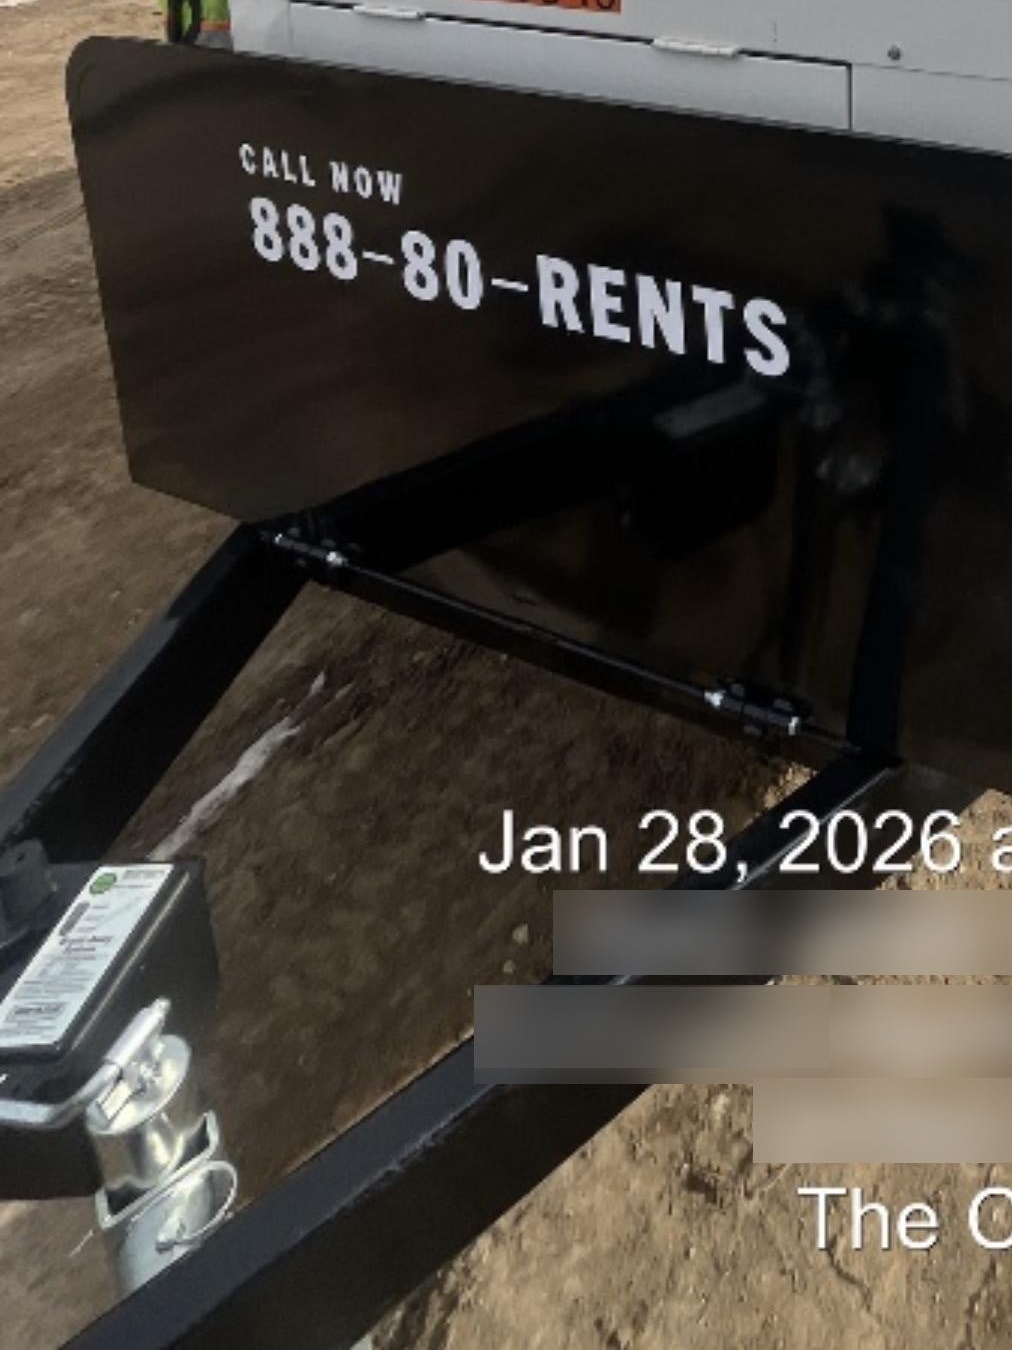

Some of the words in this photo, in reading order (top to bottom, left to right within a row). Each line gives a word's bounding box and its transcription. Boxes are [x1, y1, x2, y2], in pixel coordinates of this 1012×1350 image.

[239, 143, 316, 188] CALL
[328, 161, 402, 205] NOW
[249, 197, 790, 377] 888-80-RENTS
